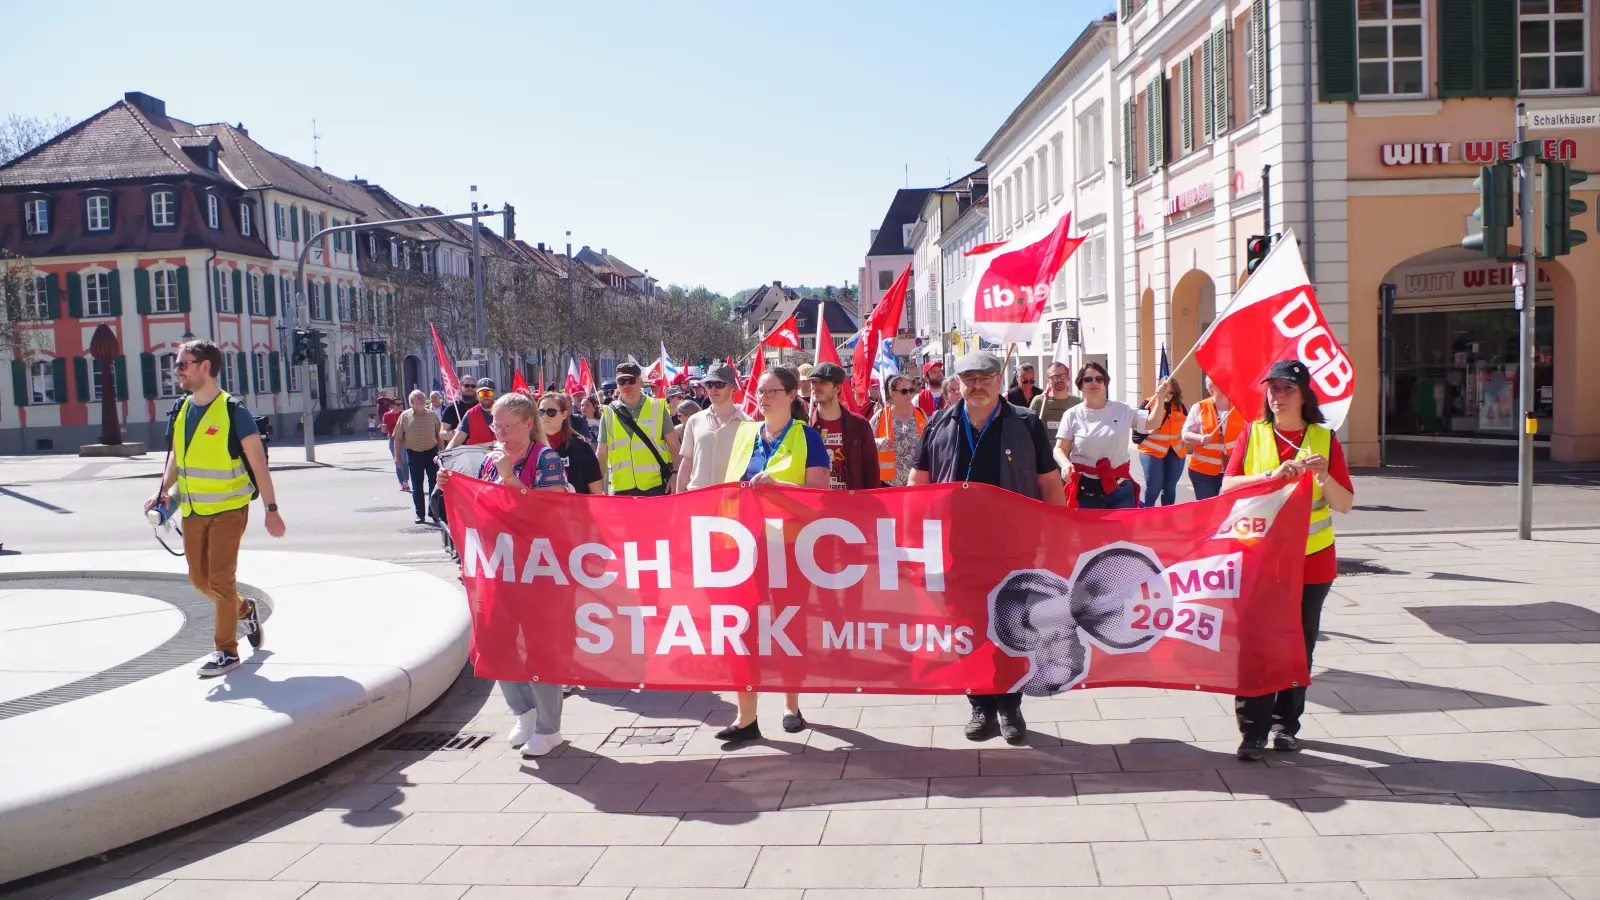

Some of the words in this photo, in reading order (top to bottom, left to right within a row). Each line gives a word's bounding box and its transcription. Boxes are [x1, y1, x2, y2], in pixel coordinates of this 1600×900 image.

[1533, 114, 1596, 126] Schalkhäuser
[1382, 142, 1452, 165] WITT
[1462, 138, 1577, 163] WEEN
[1405, 271, 1456, 293] WITT
[906, 291, 914, 329] HOTEL
[1272, 290, 1353, 397] DGB
[463, 527, 672, 589] MACH
[690, 515, 946, 592] DICH
[1170, 560, 1236, 597] Mai
[575, 603, 803, 657] STARK
[822, 621, 889, 650] MIT
[900, 624, 974, 656] UNS
[1130, 603, 1216, 641] 2025
